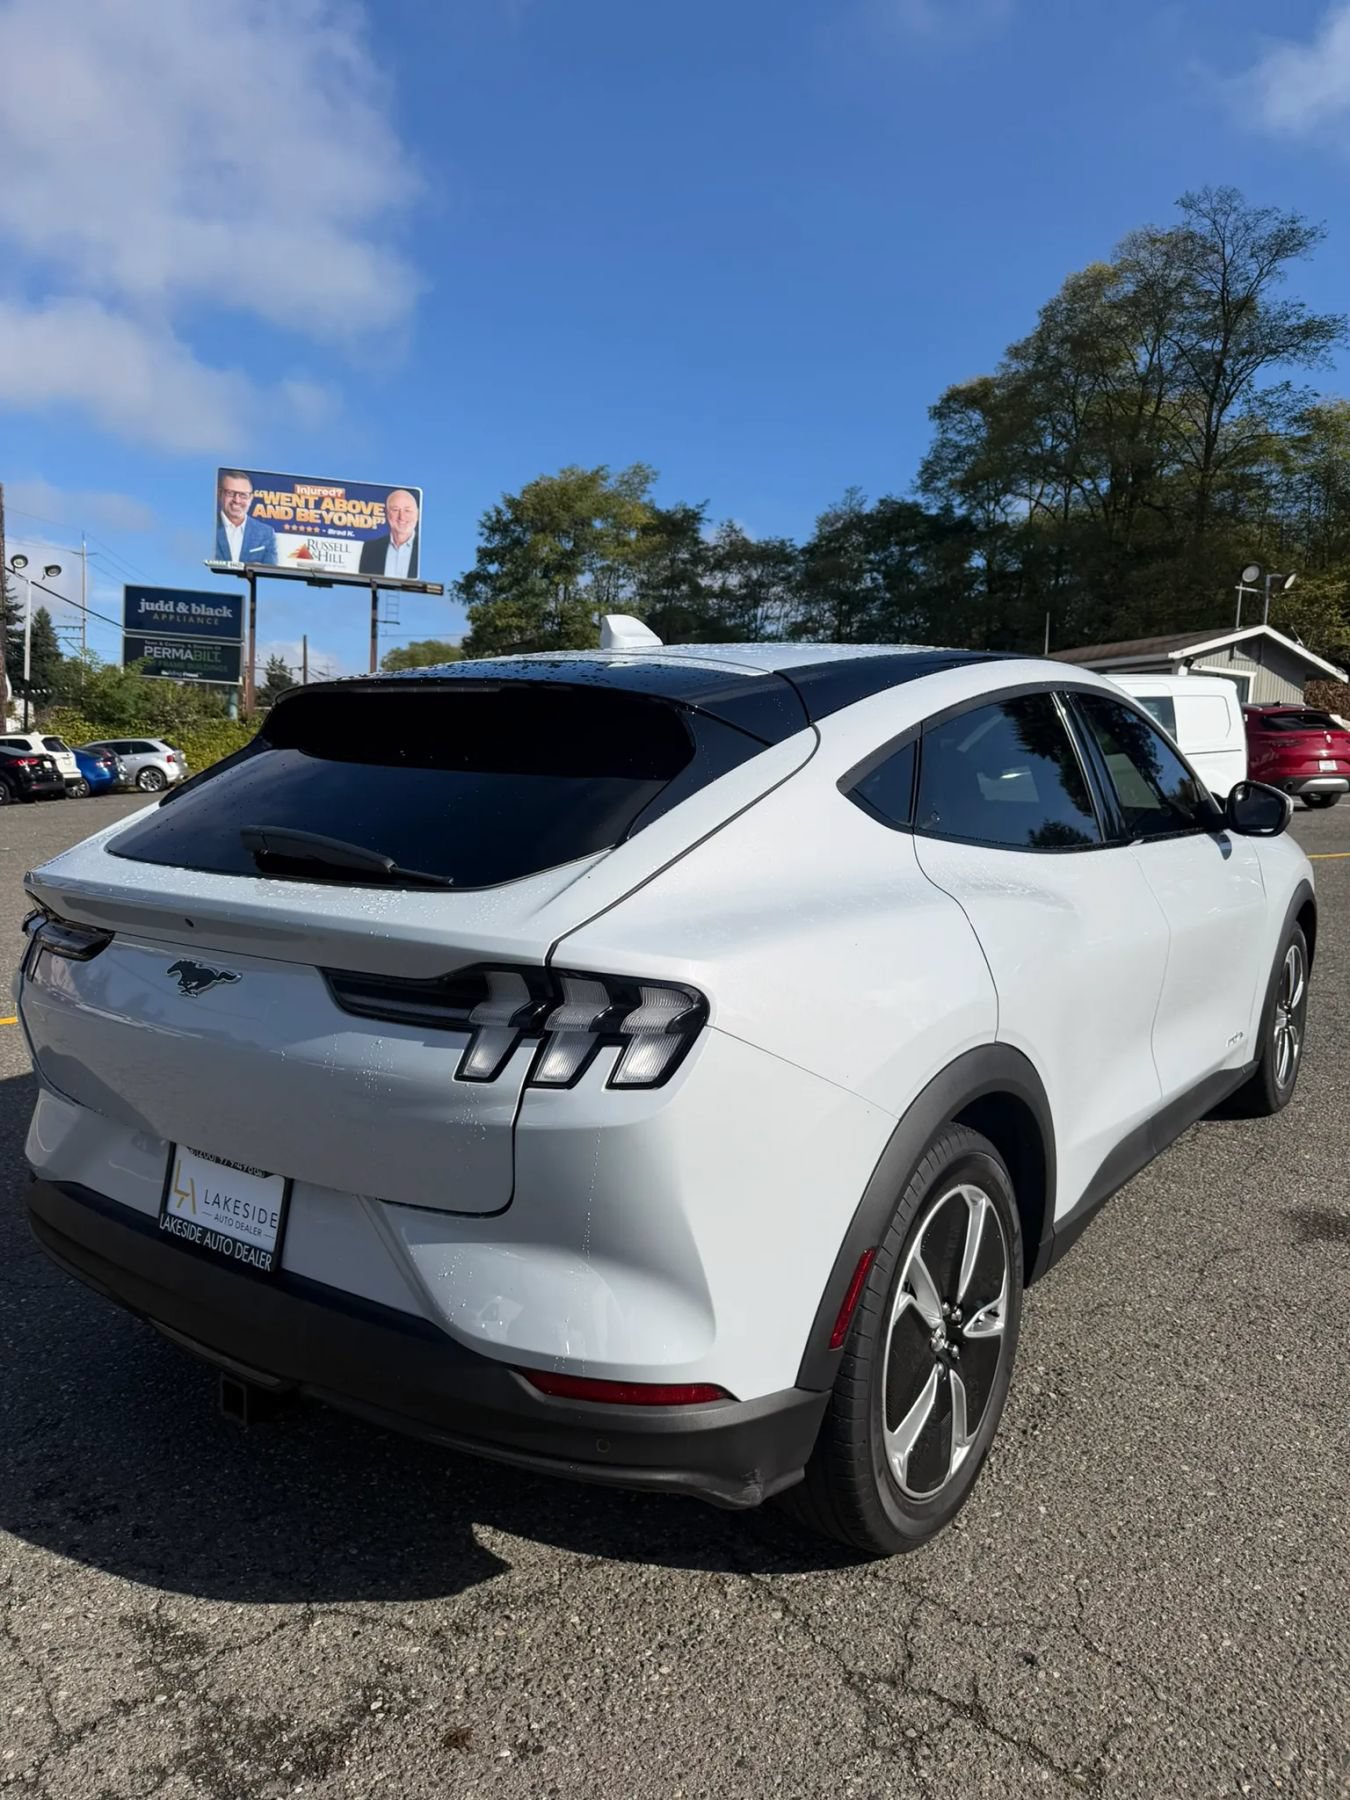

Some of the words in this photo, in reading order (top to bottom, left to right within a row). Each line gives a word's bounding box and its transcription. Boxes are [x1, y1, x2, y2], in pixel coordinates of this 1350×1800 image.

[296, 486, 343, 497] Injured?
[252, 504, 293, 520] AND
[321, 497, 386, 516] ABOVE
[307, 538, 352, 553] RUSSELL
[318, 551, 344, 564] HILL
[137, 598, 174, 613] judd
[176, 602, 189, 614] &
[191, 603, 232, 618] black
[153, 613, 219, 625] APPLIANCE
[204, 1189, 279, 1229] LAKESIDE
[214, 1214, 233, 1227] AUTO
[234, 1220, 262, 1236] DEALER
[159, 1212, 203, 1244] LAKESIDE
[203, 1231, 233, 1256] AUTO
[234, 1243, 273, 1272] DEALER
